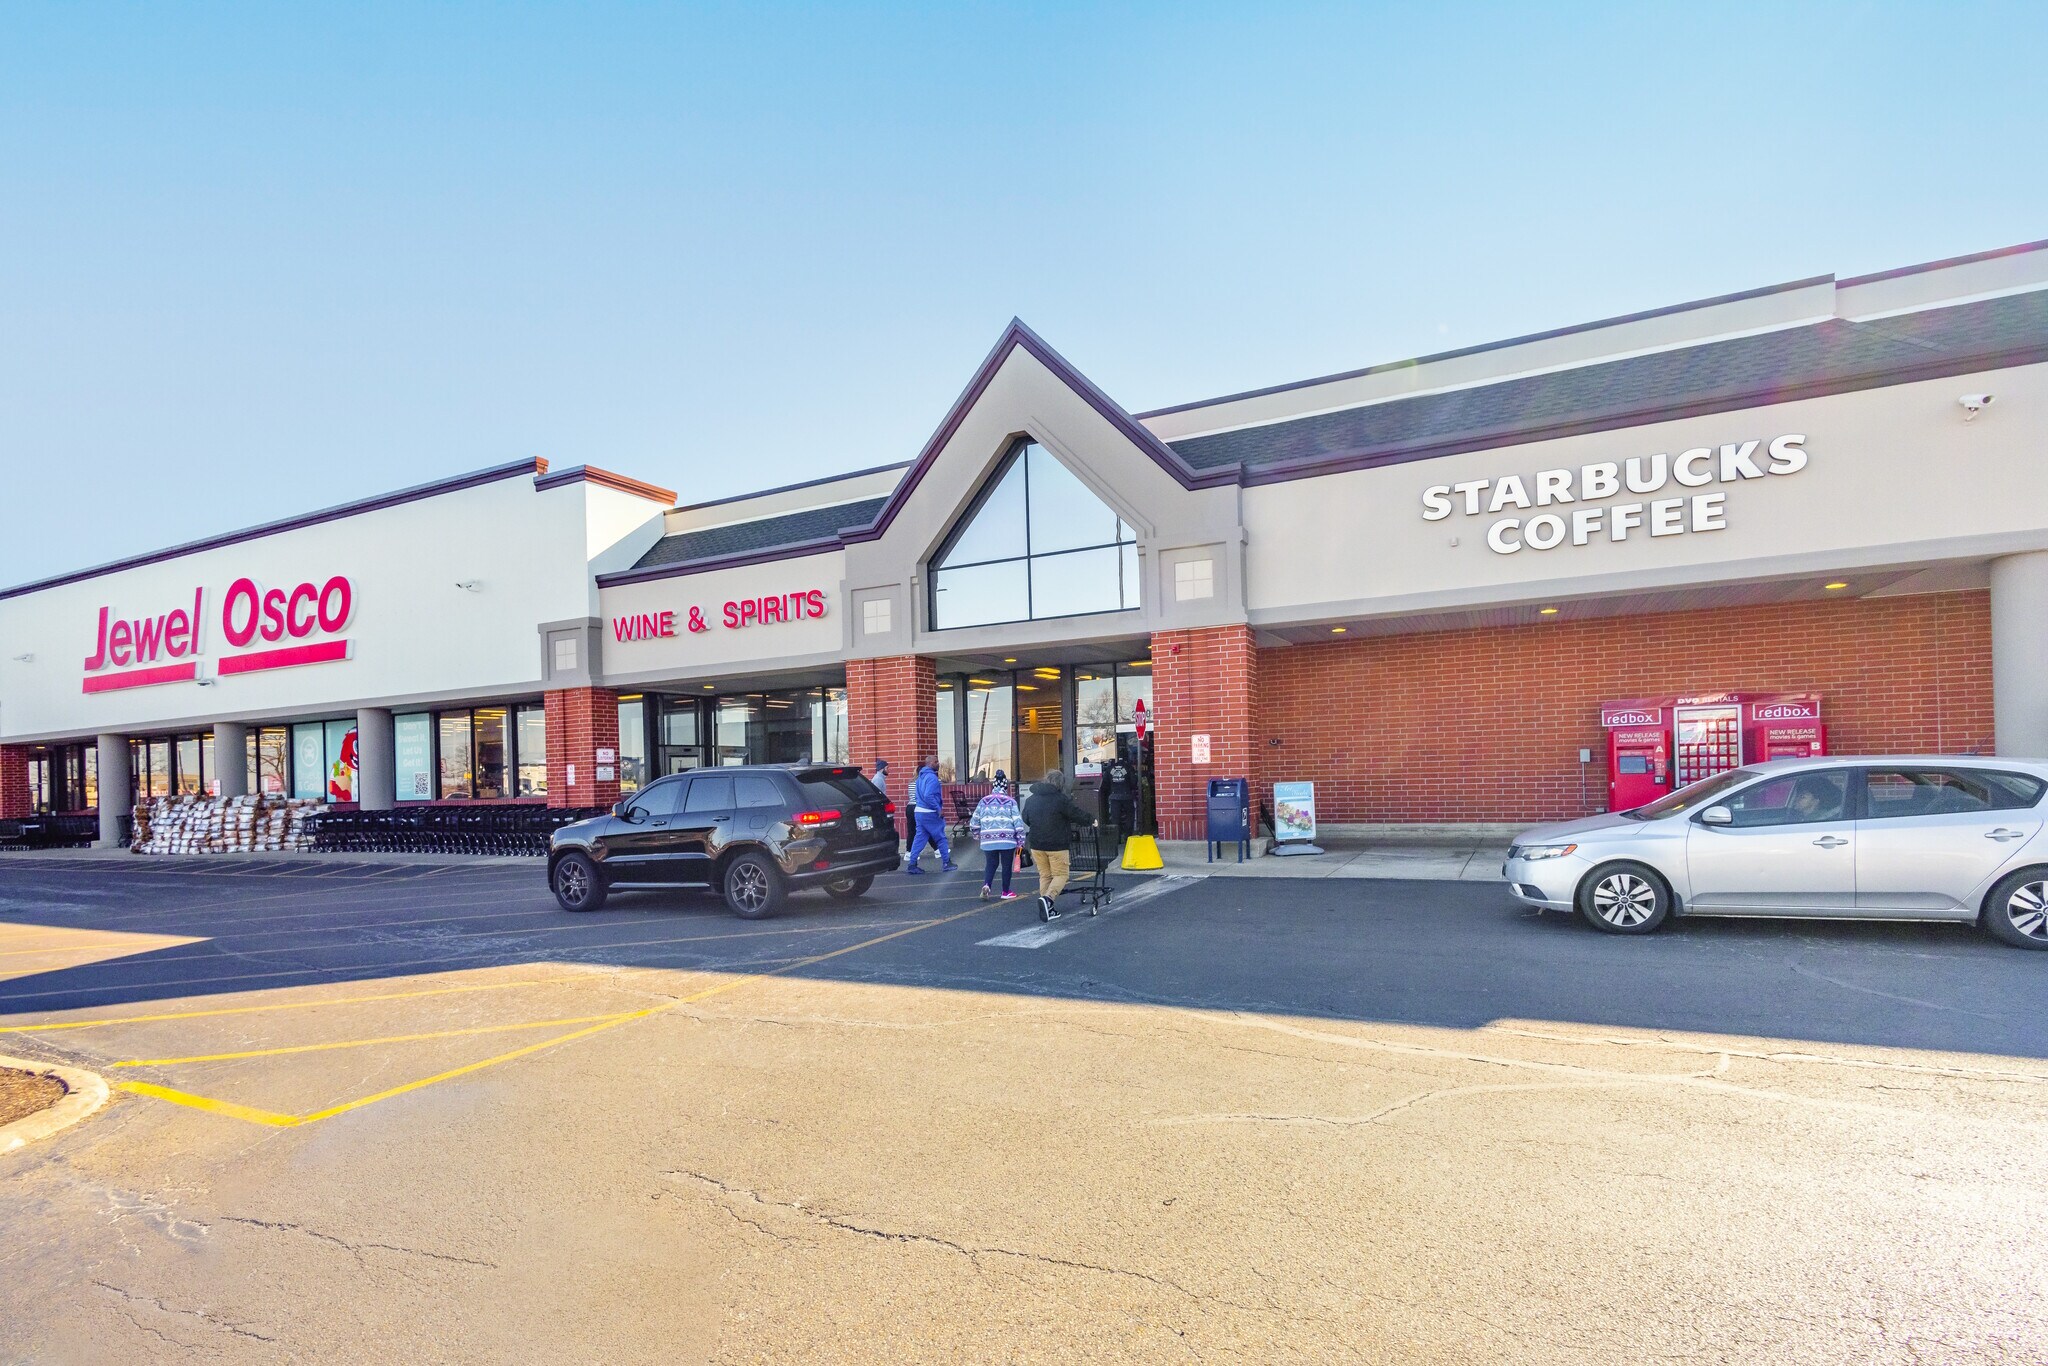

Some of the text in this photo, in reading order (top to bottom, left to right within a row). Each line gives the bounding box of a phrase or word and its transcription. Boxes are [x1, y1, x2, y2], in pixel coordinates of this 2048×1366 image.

[1422, 434, 1808, 521] STARBUCKS
[1487, 491, 1726, 554] COFFEE
[84, 575, 352, 671] Jewel Osco
[613, 589, 825, 642] WINE & SPIRITS
[1135, 712, 1146, 727] STOP
[1607, 713, 1654, 724] redbox
[1758, 706, 1811, 718] redbox
[1655, 745, 1664, 753] A
[1811, 741, 1821, 750] B
